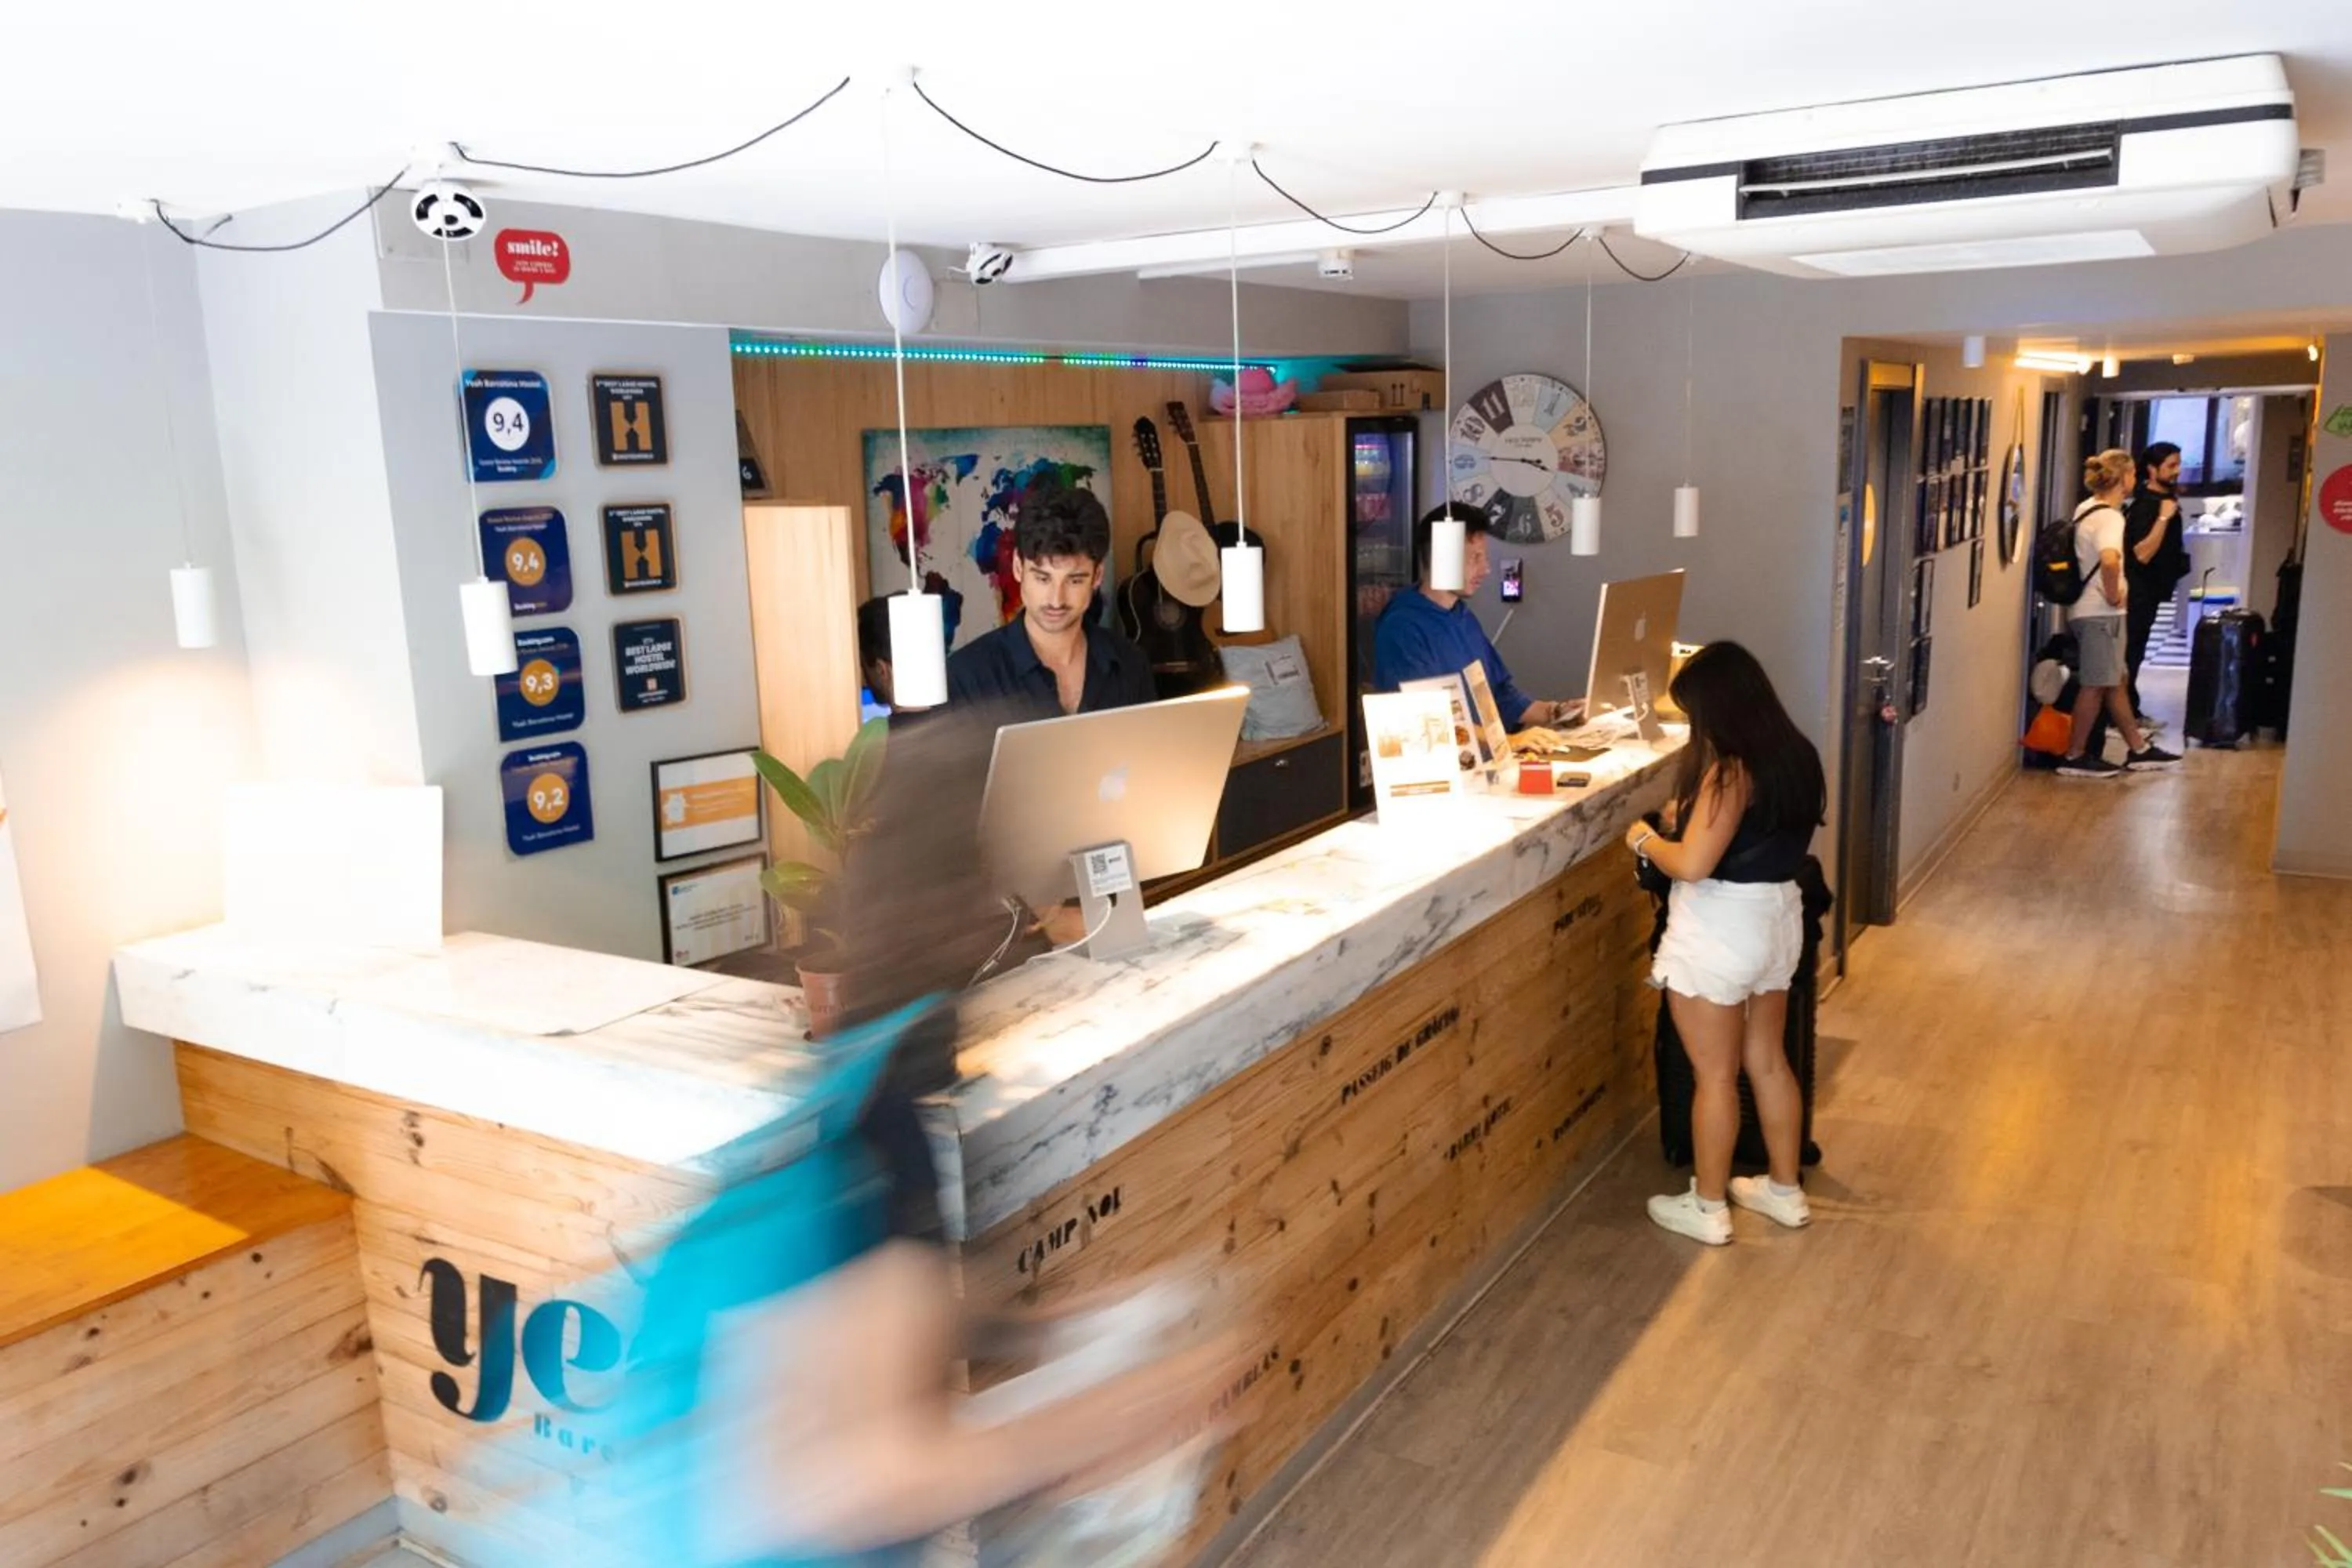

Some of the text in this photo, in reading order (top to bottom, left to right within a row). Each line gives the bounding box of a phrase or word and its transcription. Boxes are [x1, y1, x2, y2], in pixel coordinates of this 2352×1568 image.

[508, 239, 559, 257] smile!
[1482, 392, 1505, 419] 11
[1544, 394, 1561, 417] 1
[493, 412, 524, 436] 9,4
[1459, 416, 1486, 442] 10
[1563, 416, 1588, 437] 2
[1454, 454, 1476, 470] 9
[1462, 483, 1485, 503] 8
[1490, 503, 1506, 525] 7
[1518, 514, 1533, 534] 6
[1544, 503, 1565, 528] 5
[511, 552, 539, 573] 9,4
[634, 652, 664, 665] HOSTEL
[647, 642, 672, 654] LARGE
[625, 659, 676, 675] WORLDWIDE
[525, 672, 554, 694] 9,3
[532, 788, 564, 811] 9,2
[1018, 1217, 1078, 1274] CAMP
[418, 1257, 622, 1423] ye
